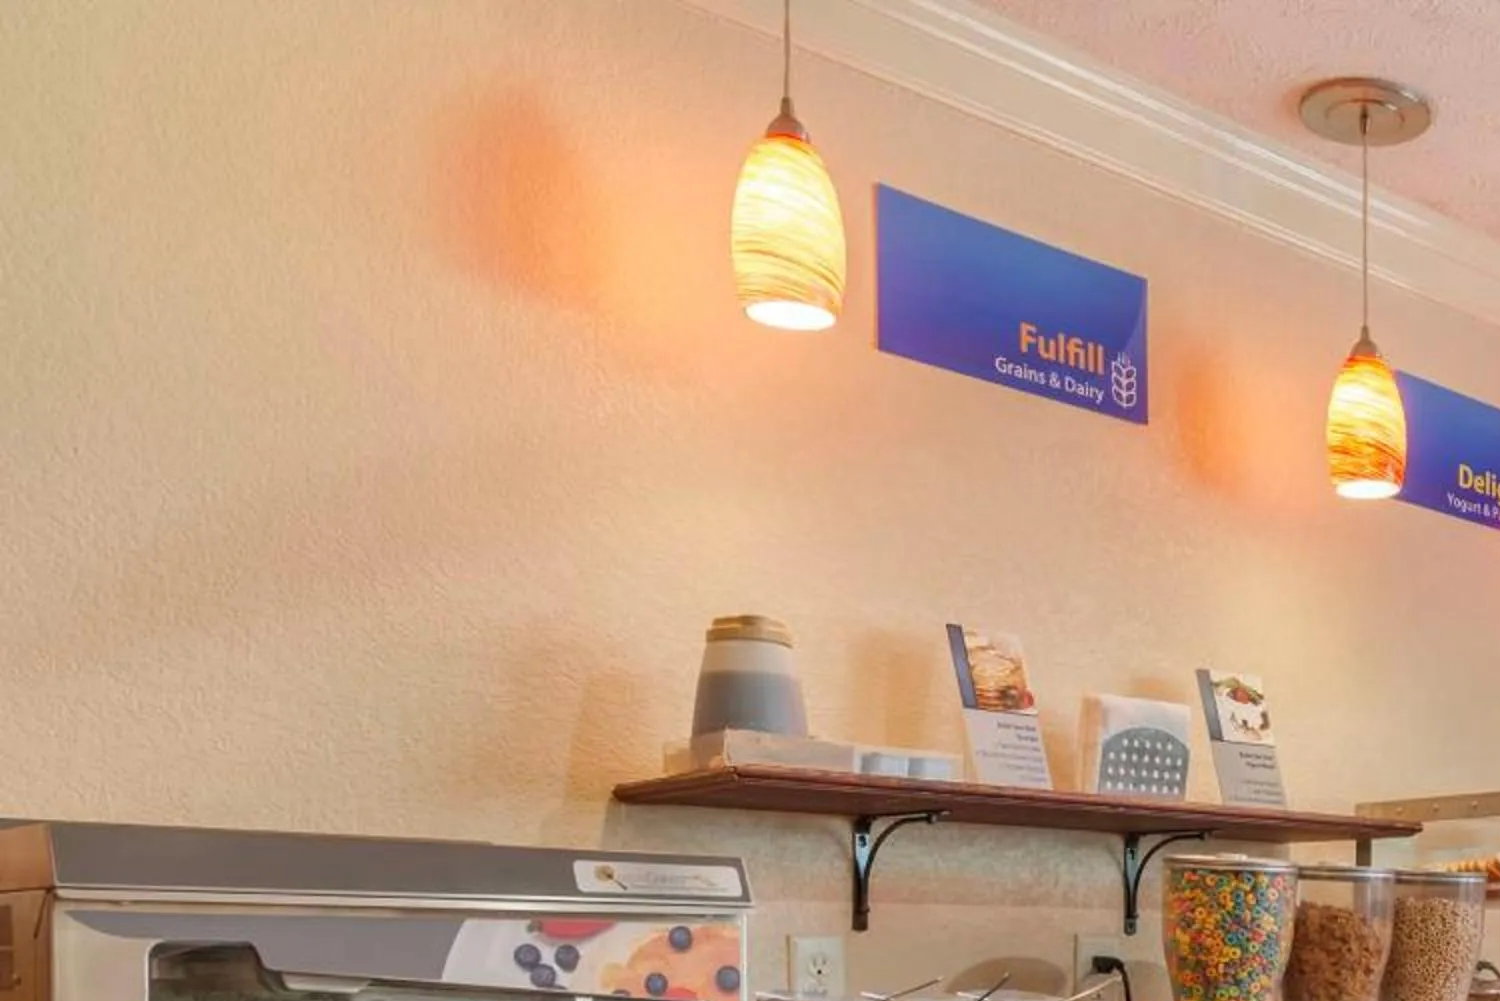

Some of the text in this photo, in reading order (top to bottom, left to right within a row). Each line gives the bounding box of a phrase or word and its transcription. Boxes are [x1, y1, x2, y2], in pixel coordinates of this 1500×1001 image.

[1019, 321, 1104, 375] Fulfill
[995, 356, 1104, 404] Grains & Dairy
[1447, 491, 1481, 513] Yogurt
[1483, 503, 1491, 517] &
